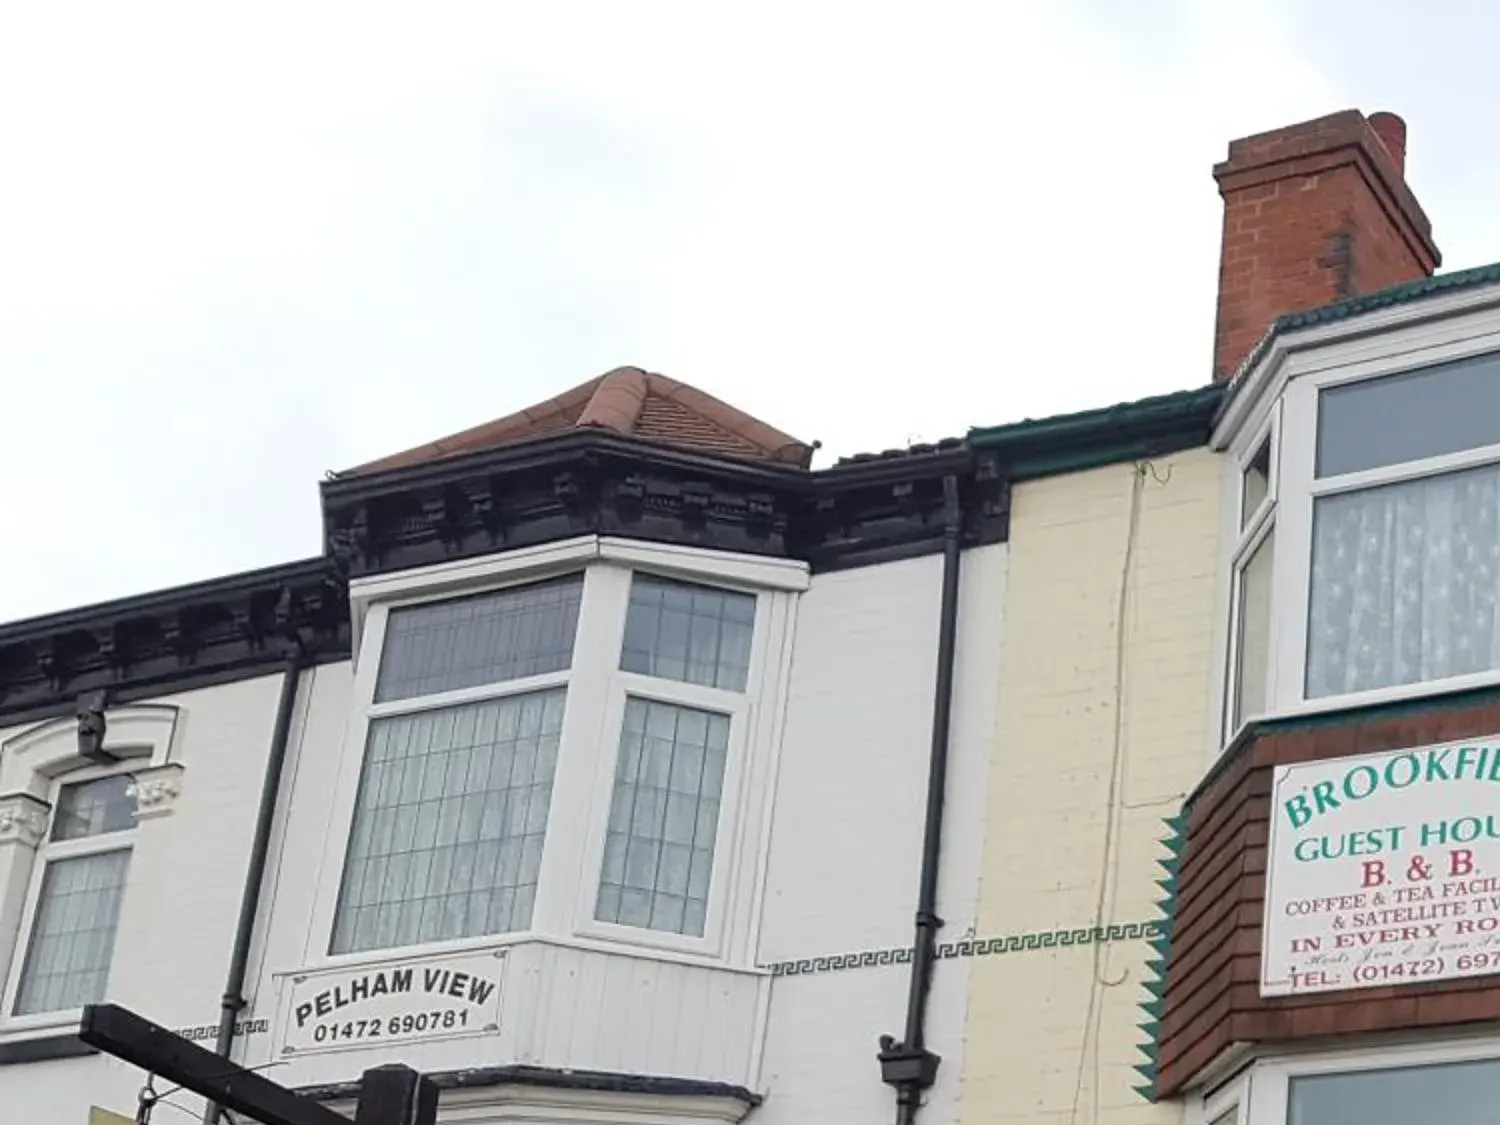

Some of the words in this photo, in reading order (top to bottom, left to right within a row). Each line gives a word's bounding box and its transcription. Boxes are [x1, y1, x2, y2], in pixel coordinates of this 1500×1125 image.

[1294, 826, 1406, 862] GUEST
[1407, 855, 1432, 882] &
[1285, 893, 1366, 915] COFFEE
[1372, 891, 1387, 906] &
[1393, 886, 1434, 902] TEA
[1332, 915, 1345, 930] &
[1353, 901, 1467, 927] SATELLITE
[1290, 936, 1321, 953] IN
[1335, 923, 1444, 949] EVERY
[1288, 971, 1341, 988] TEL:
[1353, 957, 1445, 983] (01472)
[295, 969, 413, 1027] PELHAM
[423, 969, 495, 1006] VIEW
[314, 1019, 382, 1042] 01472
[388, 1009, 469, 1034] 690781
